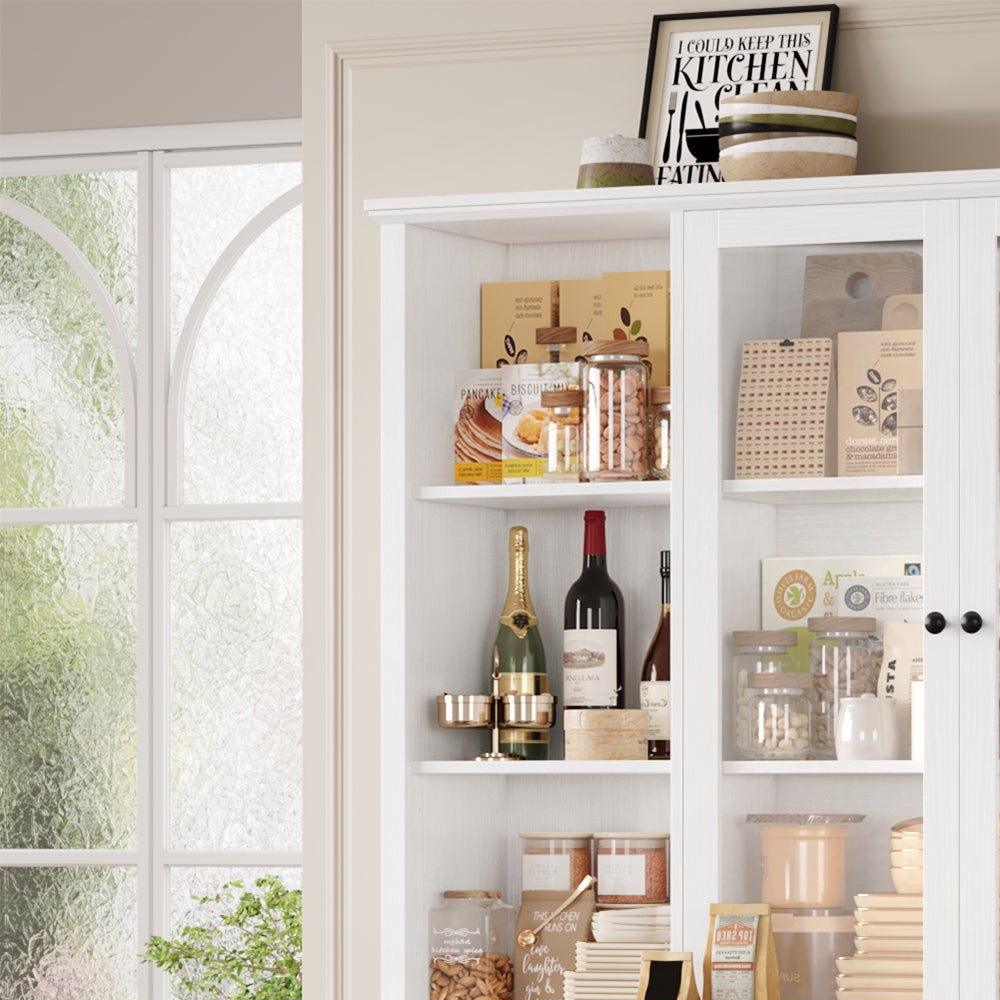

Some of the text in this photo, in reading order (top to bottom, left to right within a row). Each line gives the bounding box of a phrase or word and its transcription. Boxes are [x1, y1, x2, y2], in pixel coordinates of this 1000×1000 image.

[677, 32, 811, 54] I COULD KEEP THIS
[671, 49, 814, 92] KITCHEN
[655, 164, 726, 185] EATIN
[461, 387, 502, 400] PANCAKE
[511, 383, 548, 396] BISCUIT
[874, 592, 898, 604] Fibre
[564, 922, 577, 932] ON
